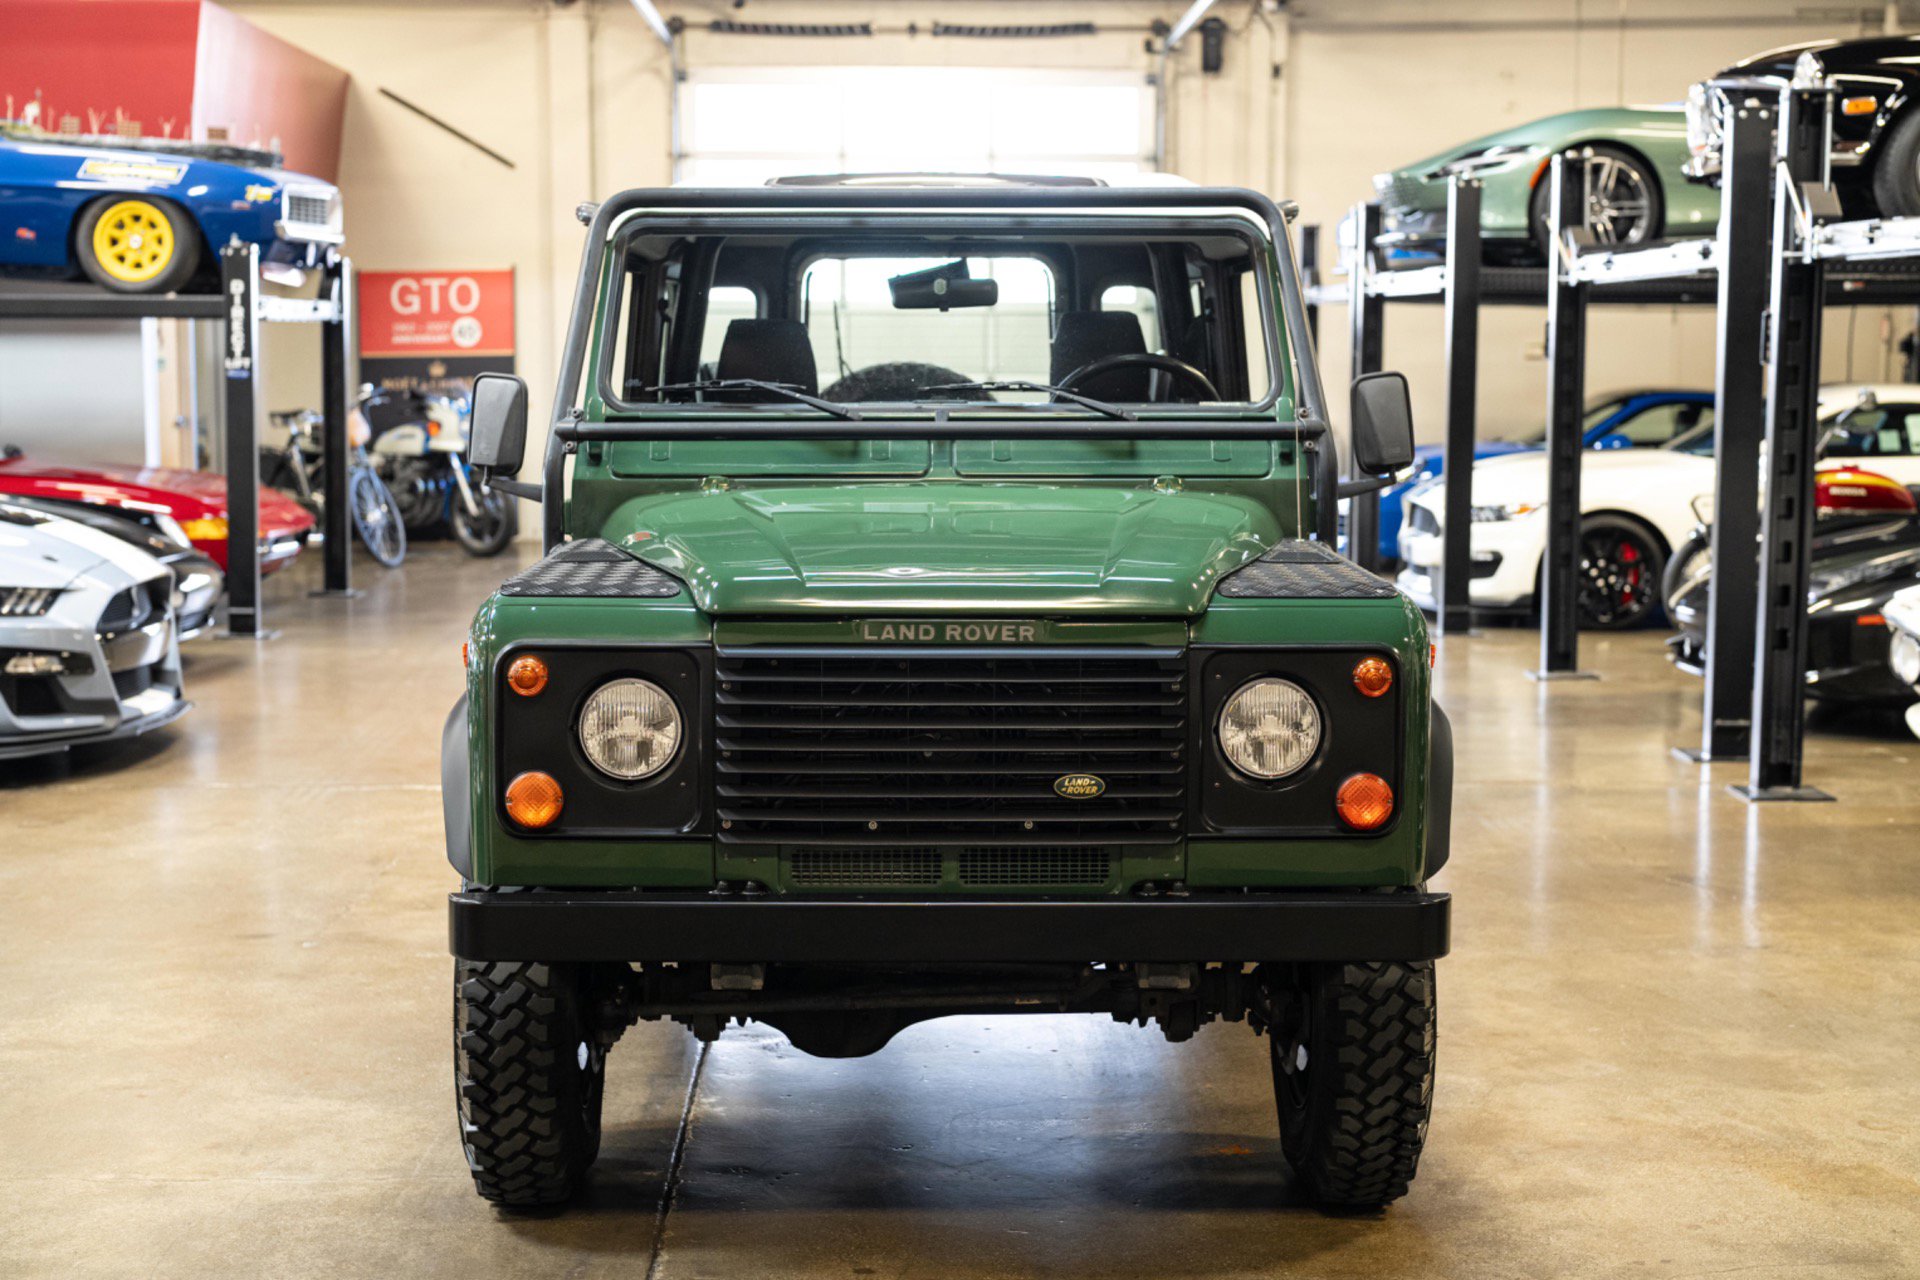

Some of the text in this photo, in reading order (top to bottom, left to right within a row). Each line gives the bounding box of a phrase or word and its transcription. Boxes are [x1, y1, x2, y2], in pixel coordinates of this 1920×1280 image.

[390, 276, 481, 316] GTO
[864, 624, 1036, 642] LAND ROVER
